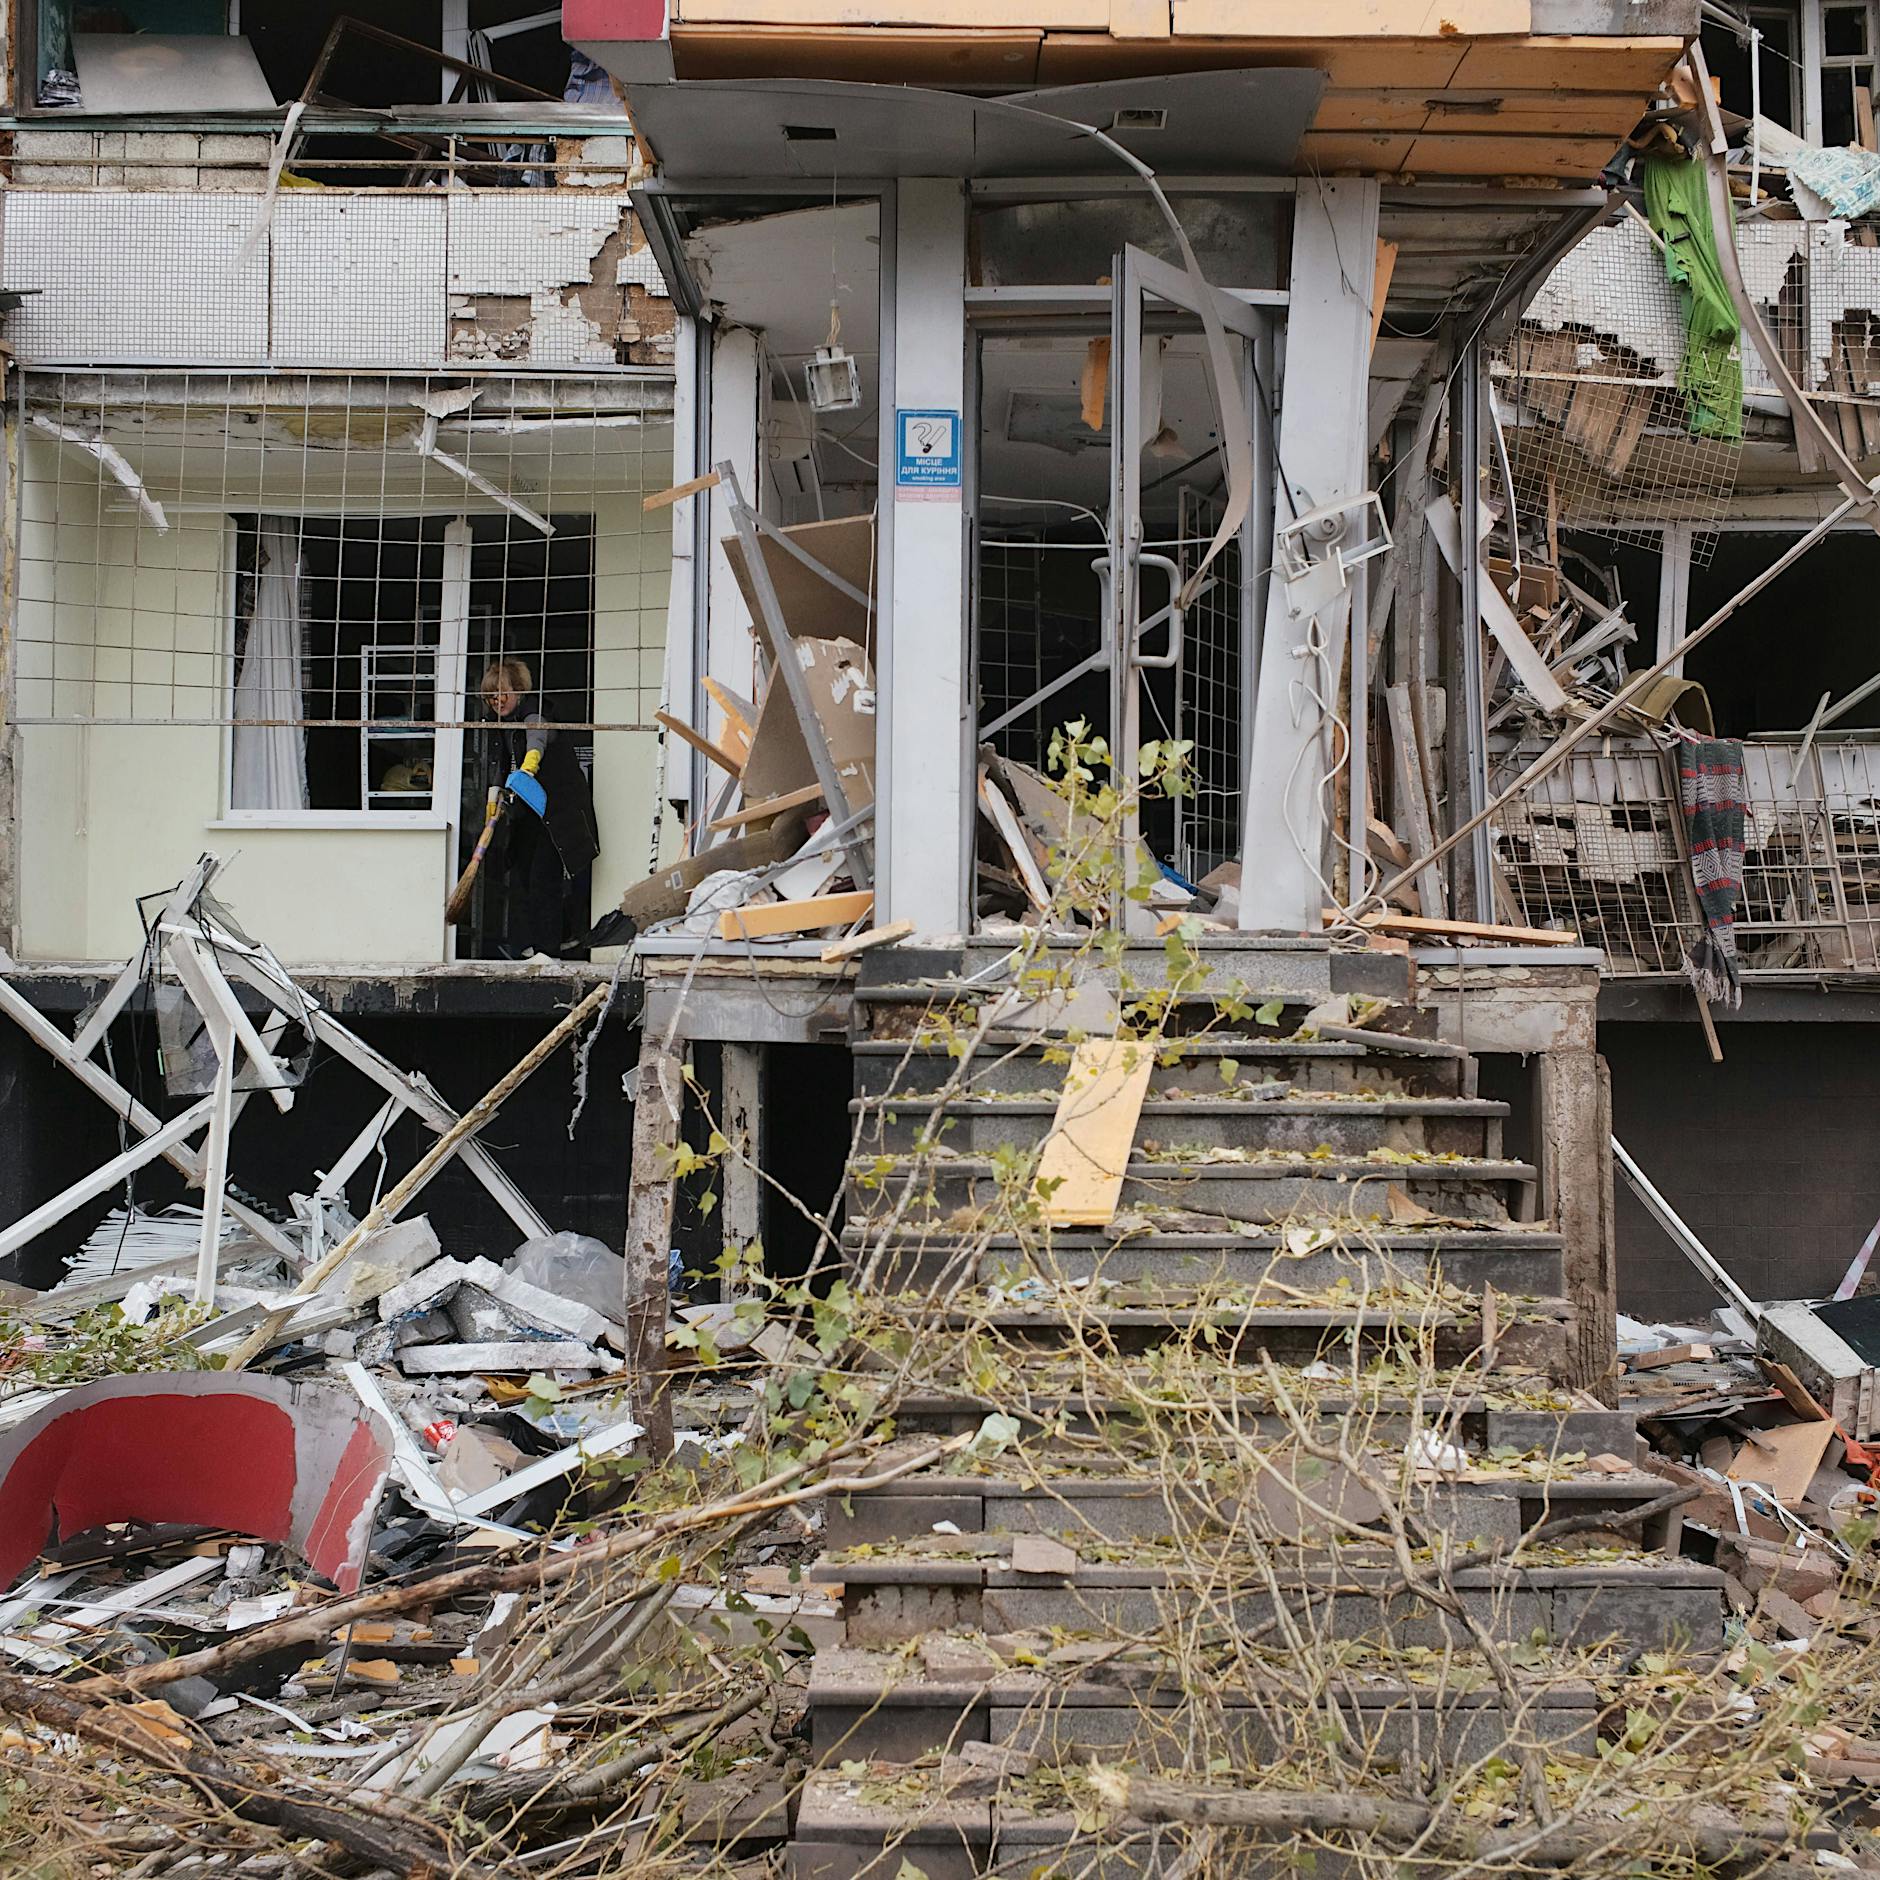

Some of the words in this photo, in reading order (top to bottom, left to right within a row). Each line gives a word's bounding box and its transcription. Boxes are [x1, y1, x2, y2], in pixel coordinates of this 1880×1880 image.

[916, 458, 942, 466] МІСЦЕ
[901, 467, 919, 475] ДЛЯ
[921, 467, 957, 475] КУРІННЯ
